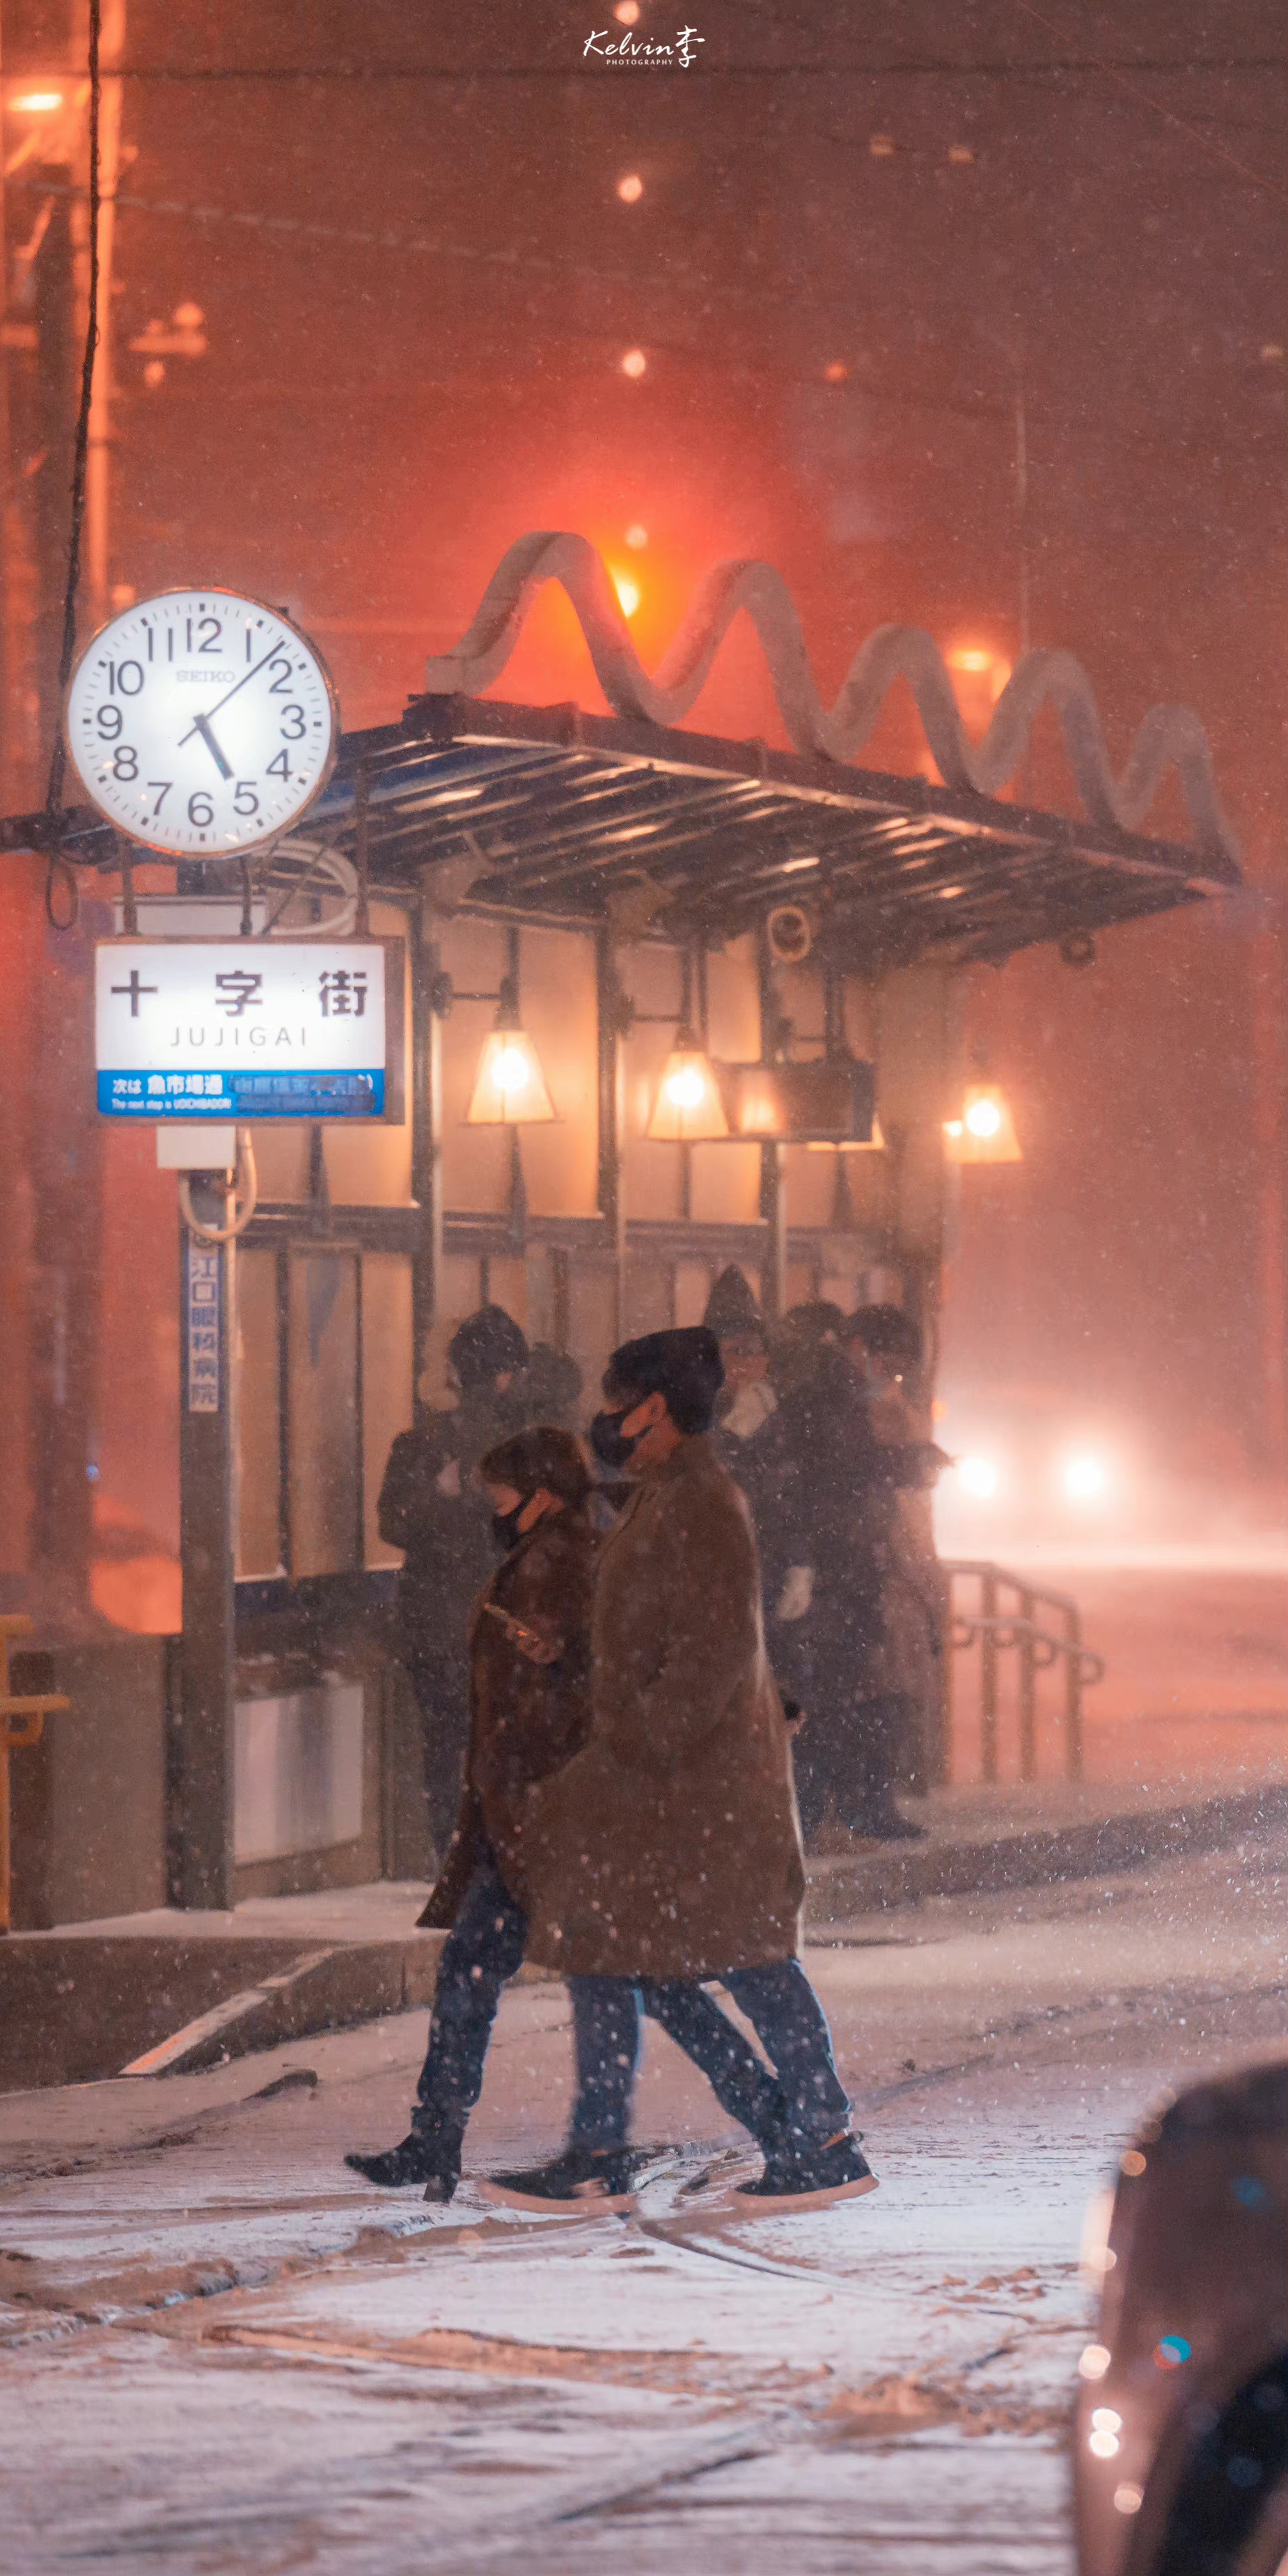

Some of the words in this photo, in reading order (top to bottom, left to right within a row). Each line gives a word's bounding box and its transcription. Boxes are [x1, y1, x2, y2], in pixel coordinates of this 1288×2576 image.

[186, 618, 222, 653] 12
[109, 660, 145, 696] 10
[176, 670, 235, 683] SEIKO
[268, 659, 293, 694] 2
[97, 705, 123, 740] 9
[280, 705, 306, 740] 3
[112, 746, 139, 781] 8
[265, 748, 292, 783] 4
[147, 781, 173, 816] 7
[187, 792, 214, 827] 6
[233, 781, 259, 816] 5
[111, 970, 368, 1017] 十字街
[171, 1027, 306, 1046] JUJIGAI
